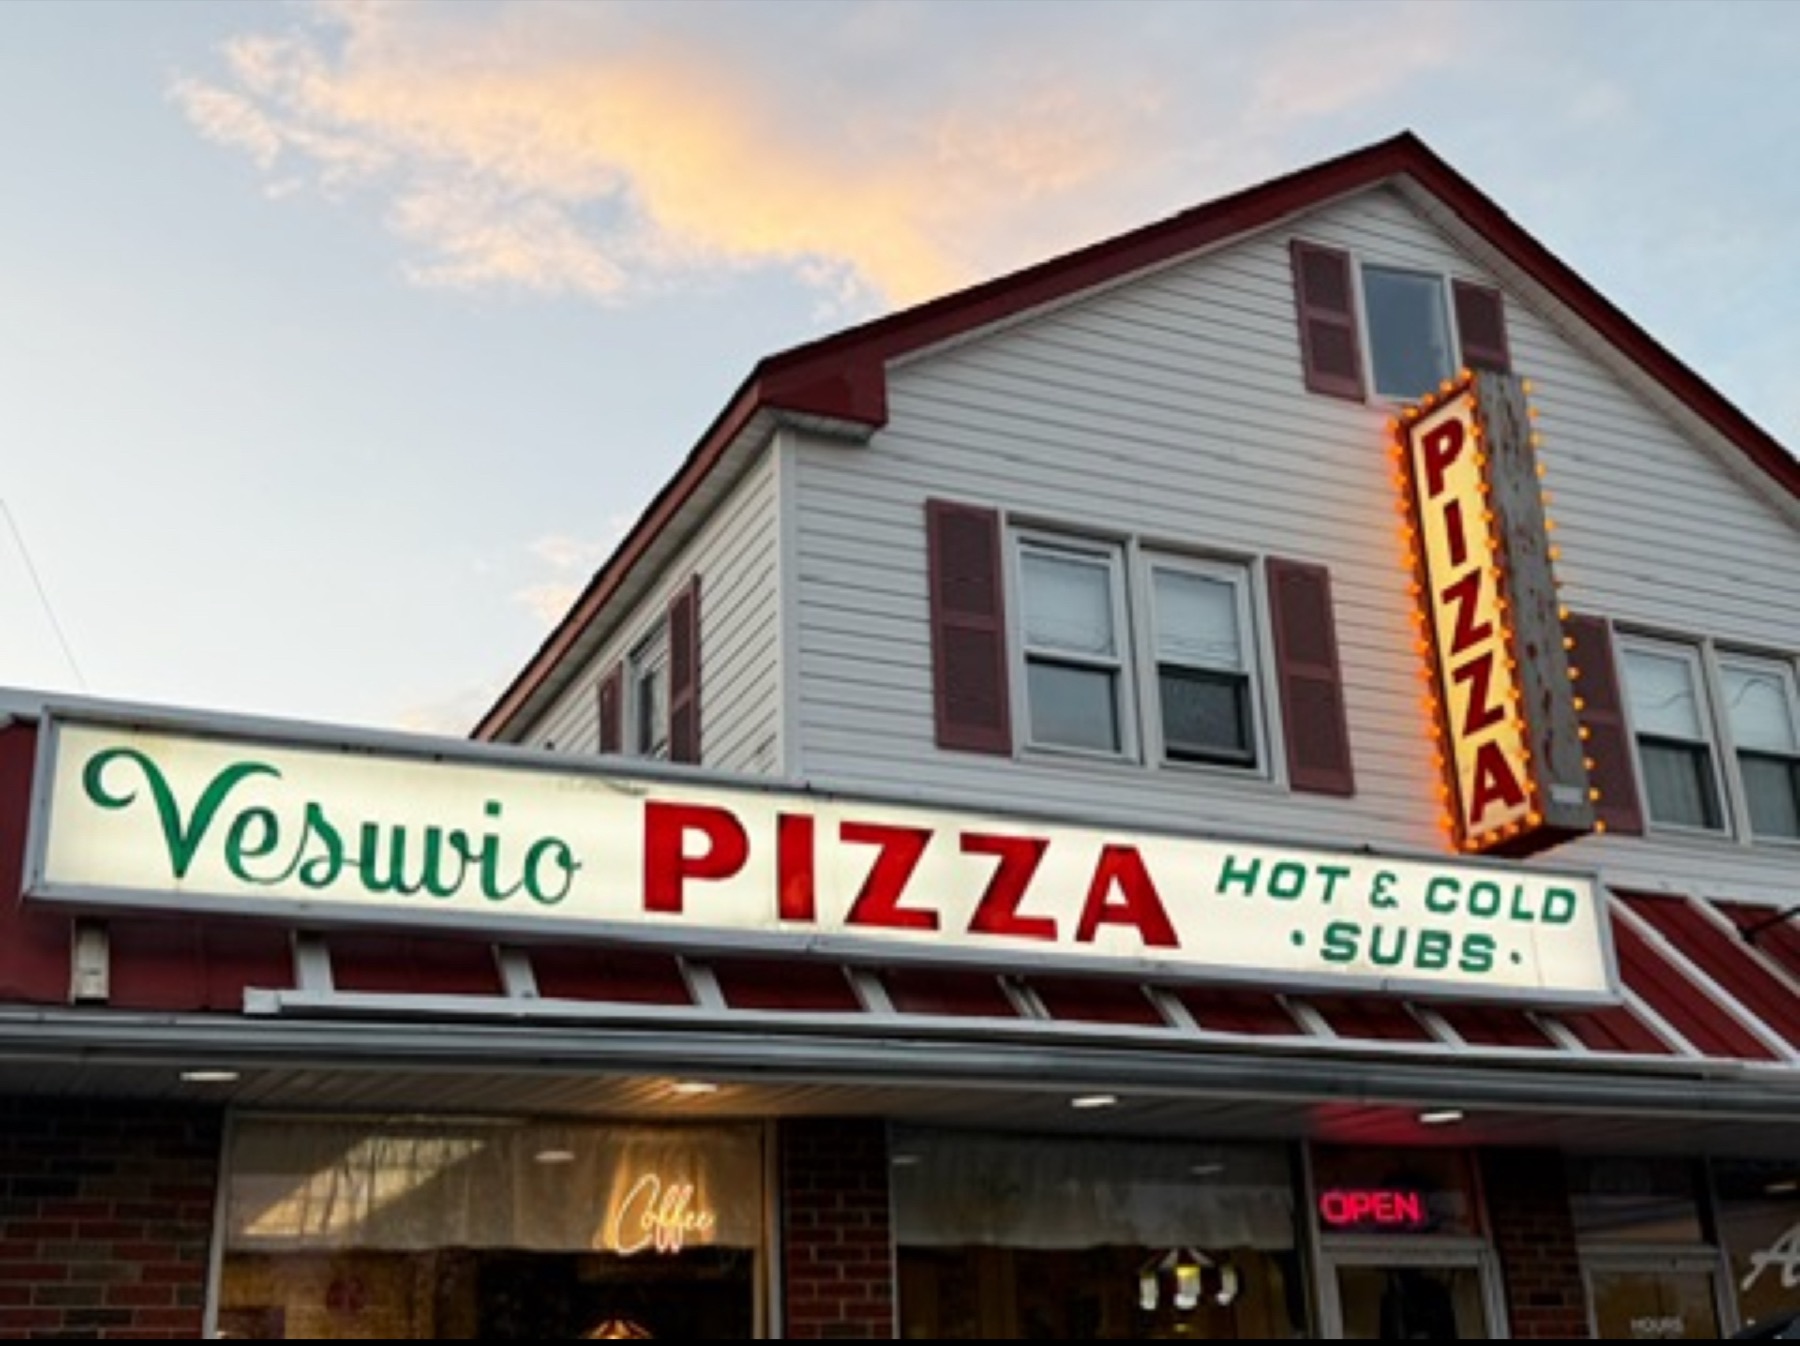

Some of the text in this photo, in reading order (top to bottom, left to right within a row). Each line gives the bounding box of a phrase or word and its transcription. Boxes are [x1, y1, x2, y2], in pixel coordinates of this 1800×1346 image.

[1421, 418, 1528, 824] PIZZA
[82, 748, 1181, 948] Vesuvio PIZZA
[1216, 855, 1577, 924] HOT & COLD
[615, 1173, 715, 1255] Coffee
[1320, 1190, 1420, 1223] OPEN
